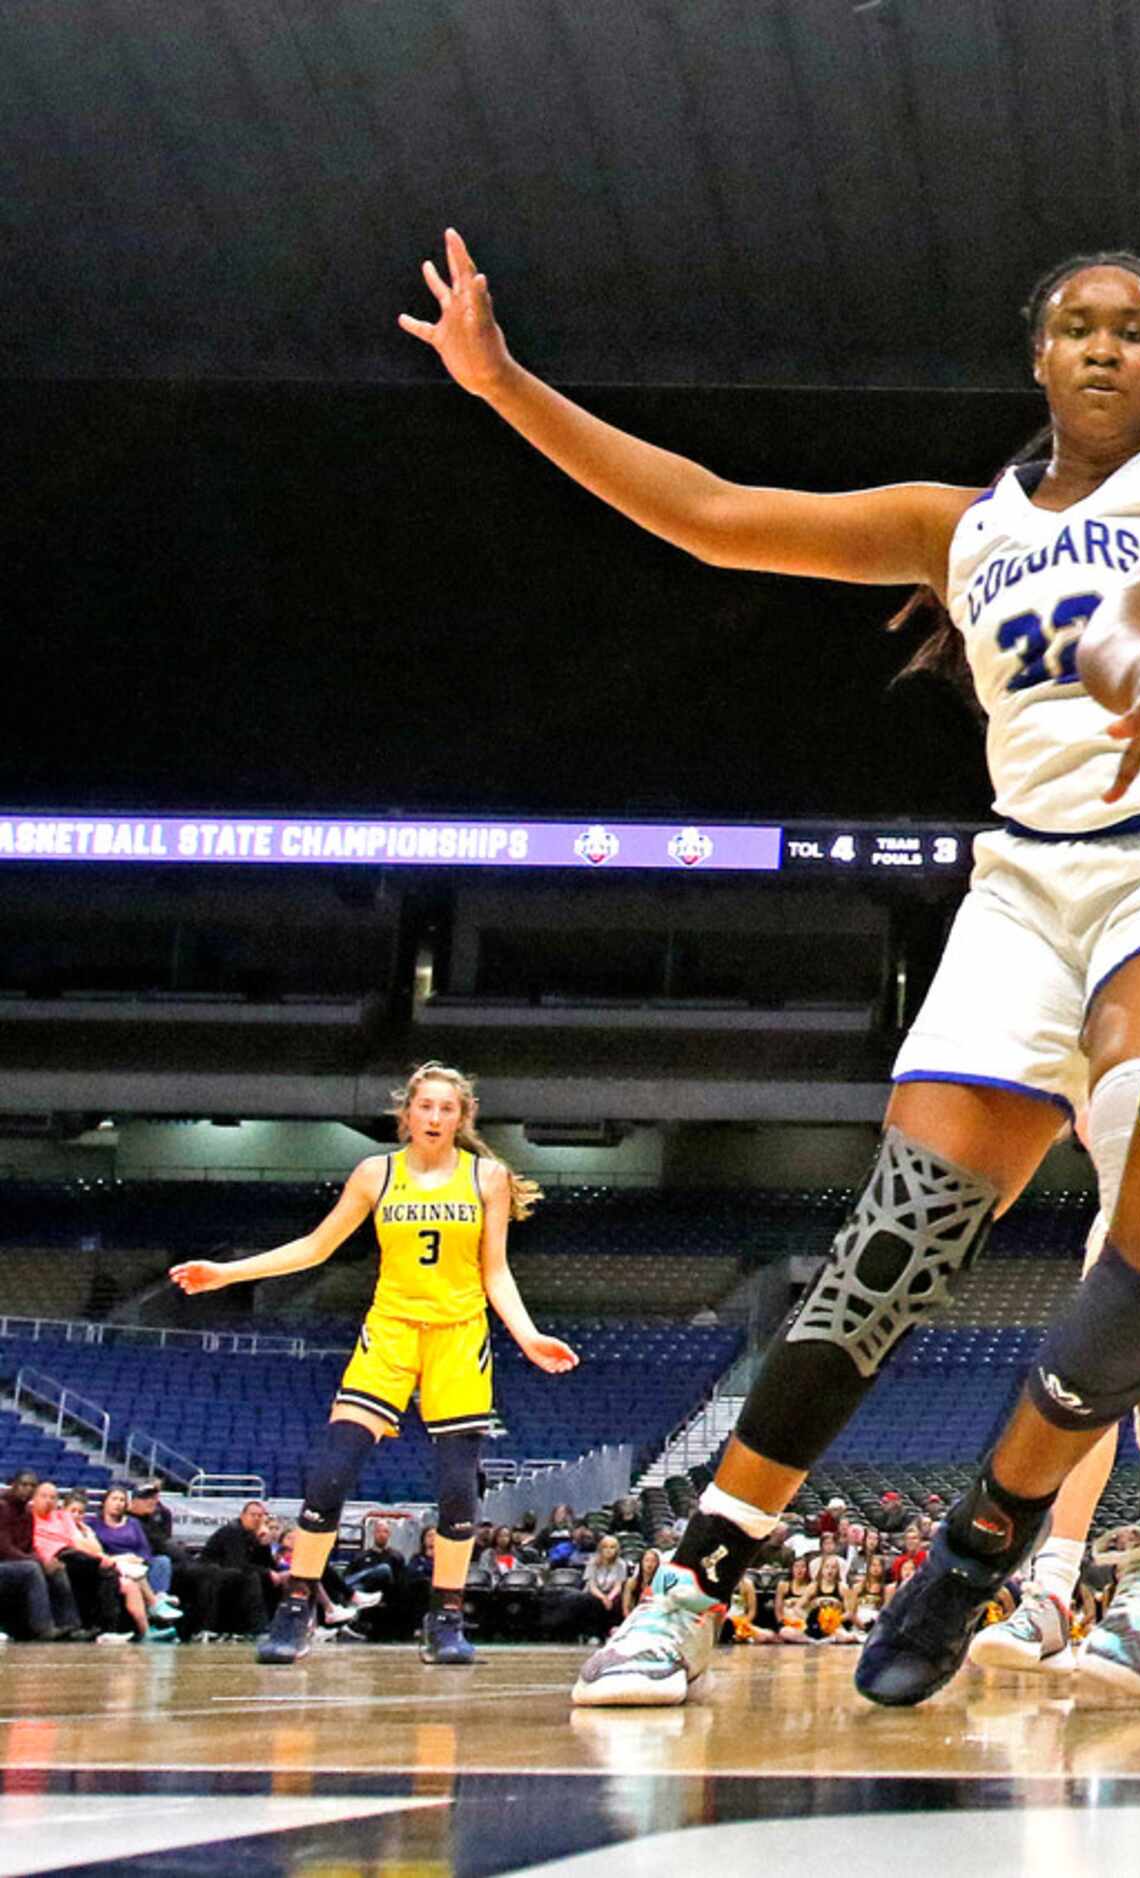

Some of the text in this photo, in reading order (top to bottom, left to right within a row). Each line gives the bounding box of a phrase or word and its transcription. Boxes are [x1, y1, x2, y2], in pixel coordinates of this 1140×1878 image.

[0, 822, 529, 859] ASKETBALL STATE CHAMPIONSHIPS
[788, 835, 856, 861] TOL 4
[382, 1204, 478, 1223] MCKINNEY
[418, 1229, 441, 1266] 3
